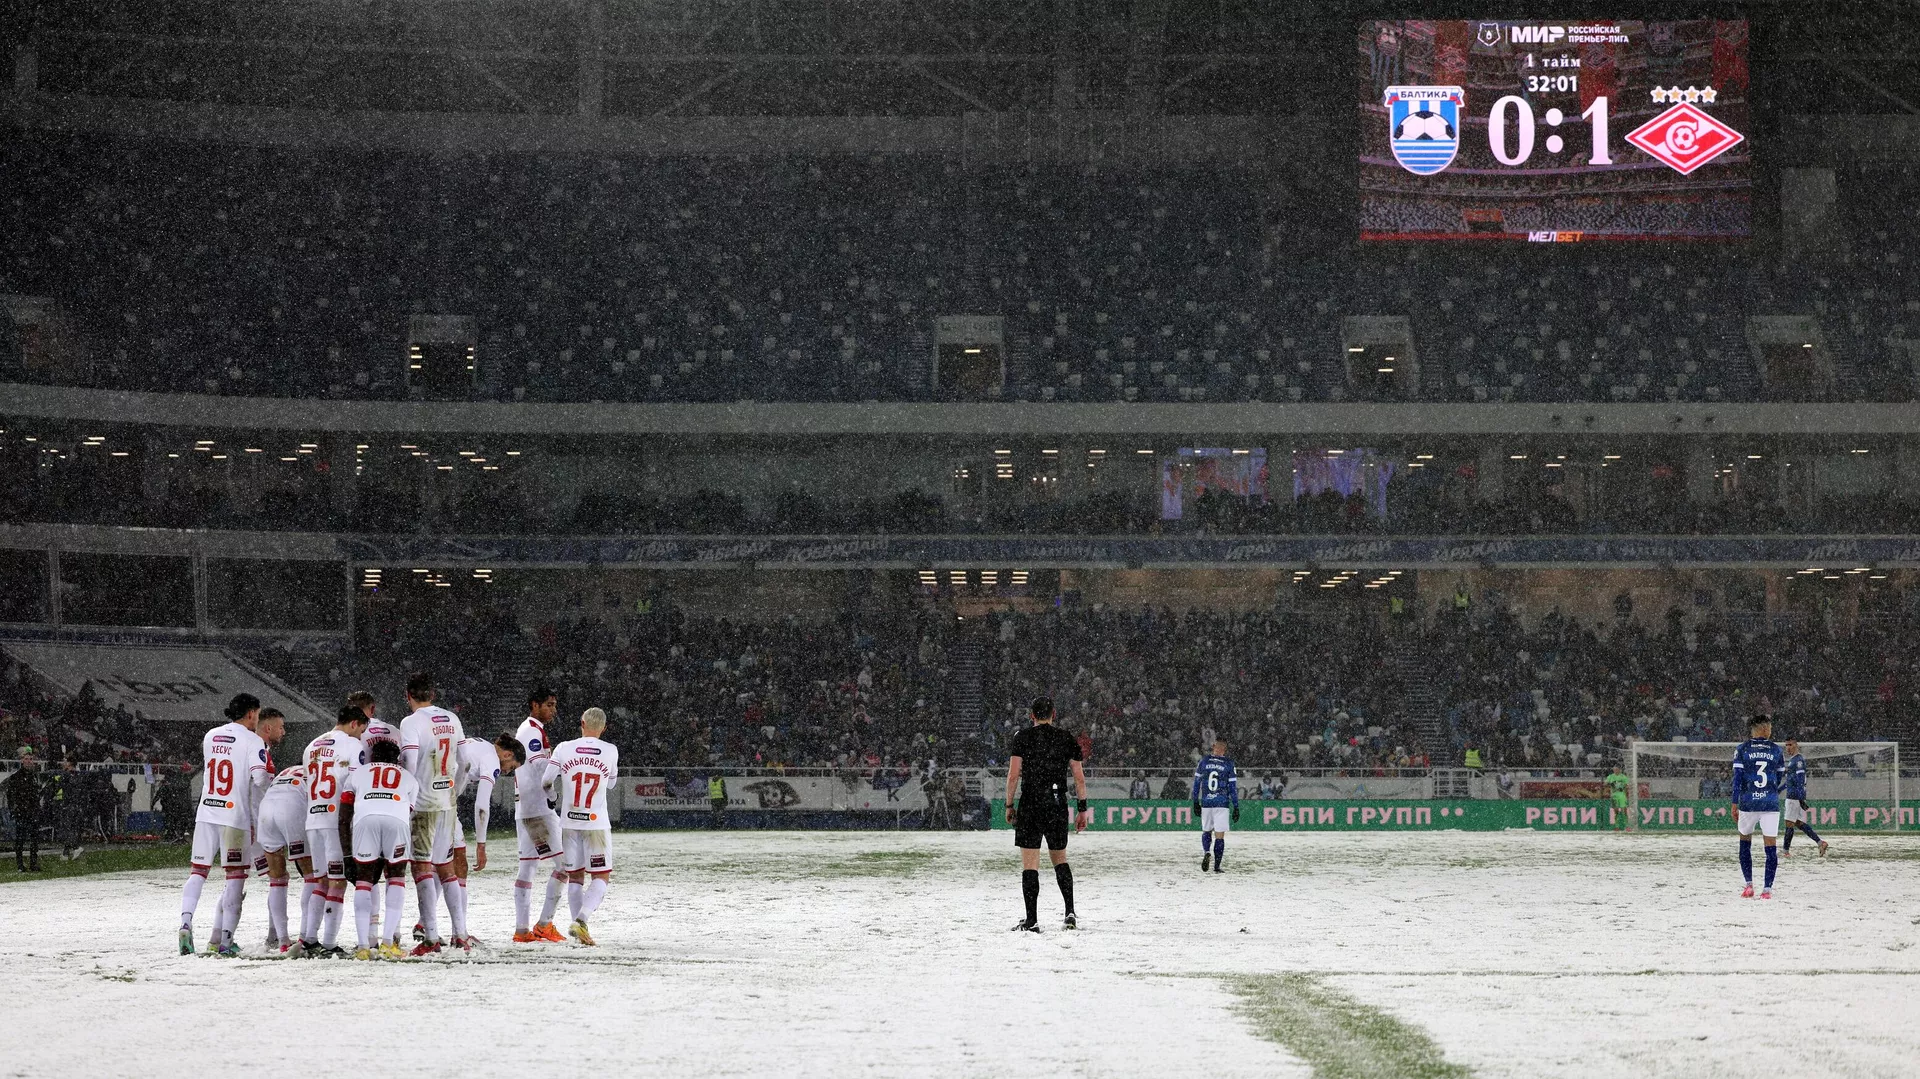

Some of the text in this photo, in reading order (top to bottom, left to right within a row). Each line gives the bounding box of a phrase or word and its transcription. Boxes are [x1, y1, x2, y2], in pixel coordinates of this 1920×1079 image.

[1511, 26, 1565, 43] МИР
[1568, 24, 1620, 34] РОССИЙСКАЯ
[1568, 35, 1629, 43] ПРЕМЬЕР-ЛИГА
[1526, 53, 1581, 67] 1 тайм
[1528, 75, 1577, 92] 32:01
[1400, 90, 1448, 99] БАЛТИКА
[1528, 231, 1583, 242] МЕЛБЕТ
[432, 725, 455, 736] СОБОЛЕВ
[212, 746, 233, 755] ХЕСУС
[439, 738, 450, 777] 7
[207, 758, 234, 796] 19
[308, 761, 337, 801] 25
[369, 766, 402, 790] 10
[1208, 771, 1219, 791] 6
[1753, 761, 1768, 788] 3
[571, 772, 601, 808] 17
[1107, 807, 1191, 824] ГРУПП
[1263, 807, 1431, 824] РБПИ ГРУПП
[1526, 807, 1597, 824] РБПИ
